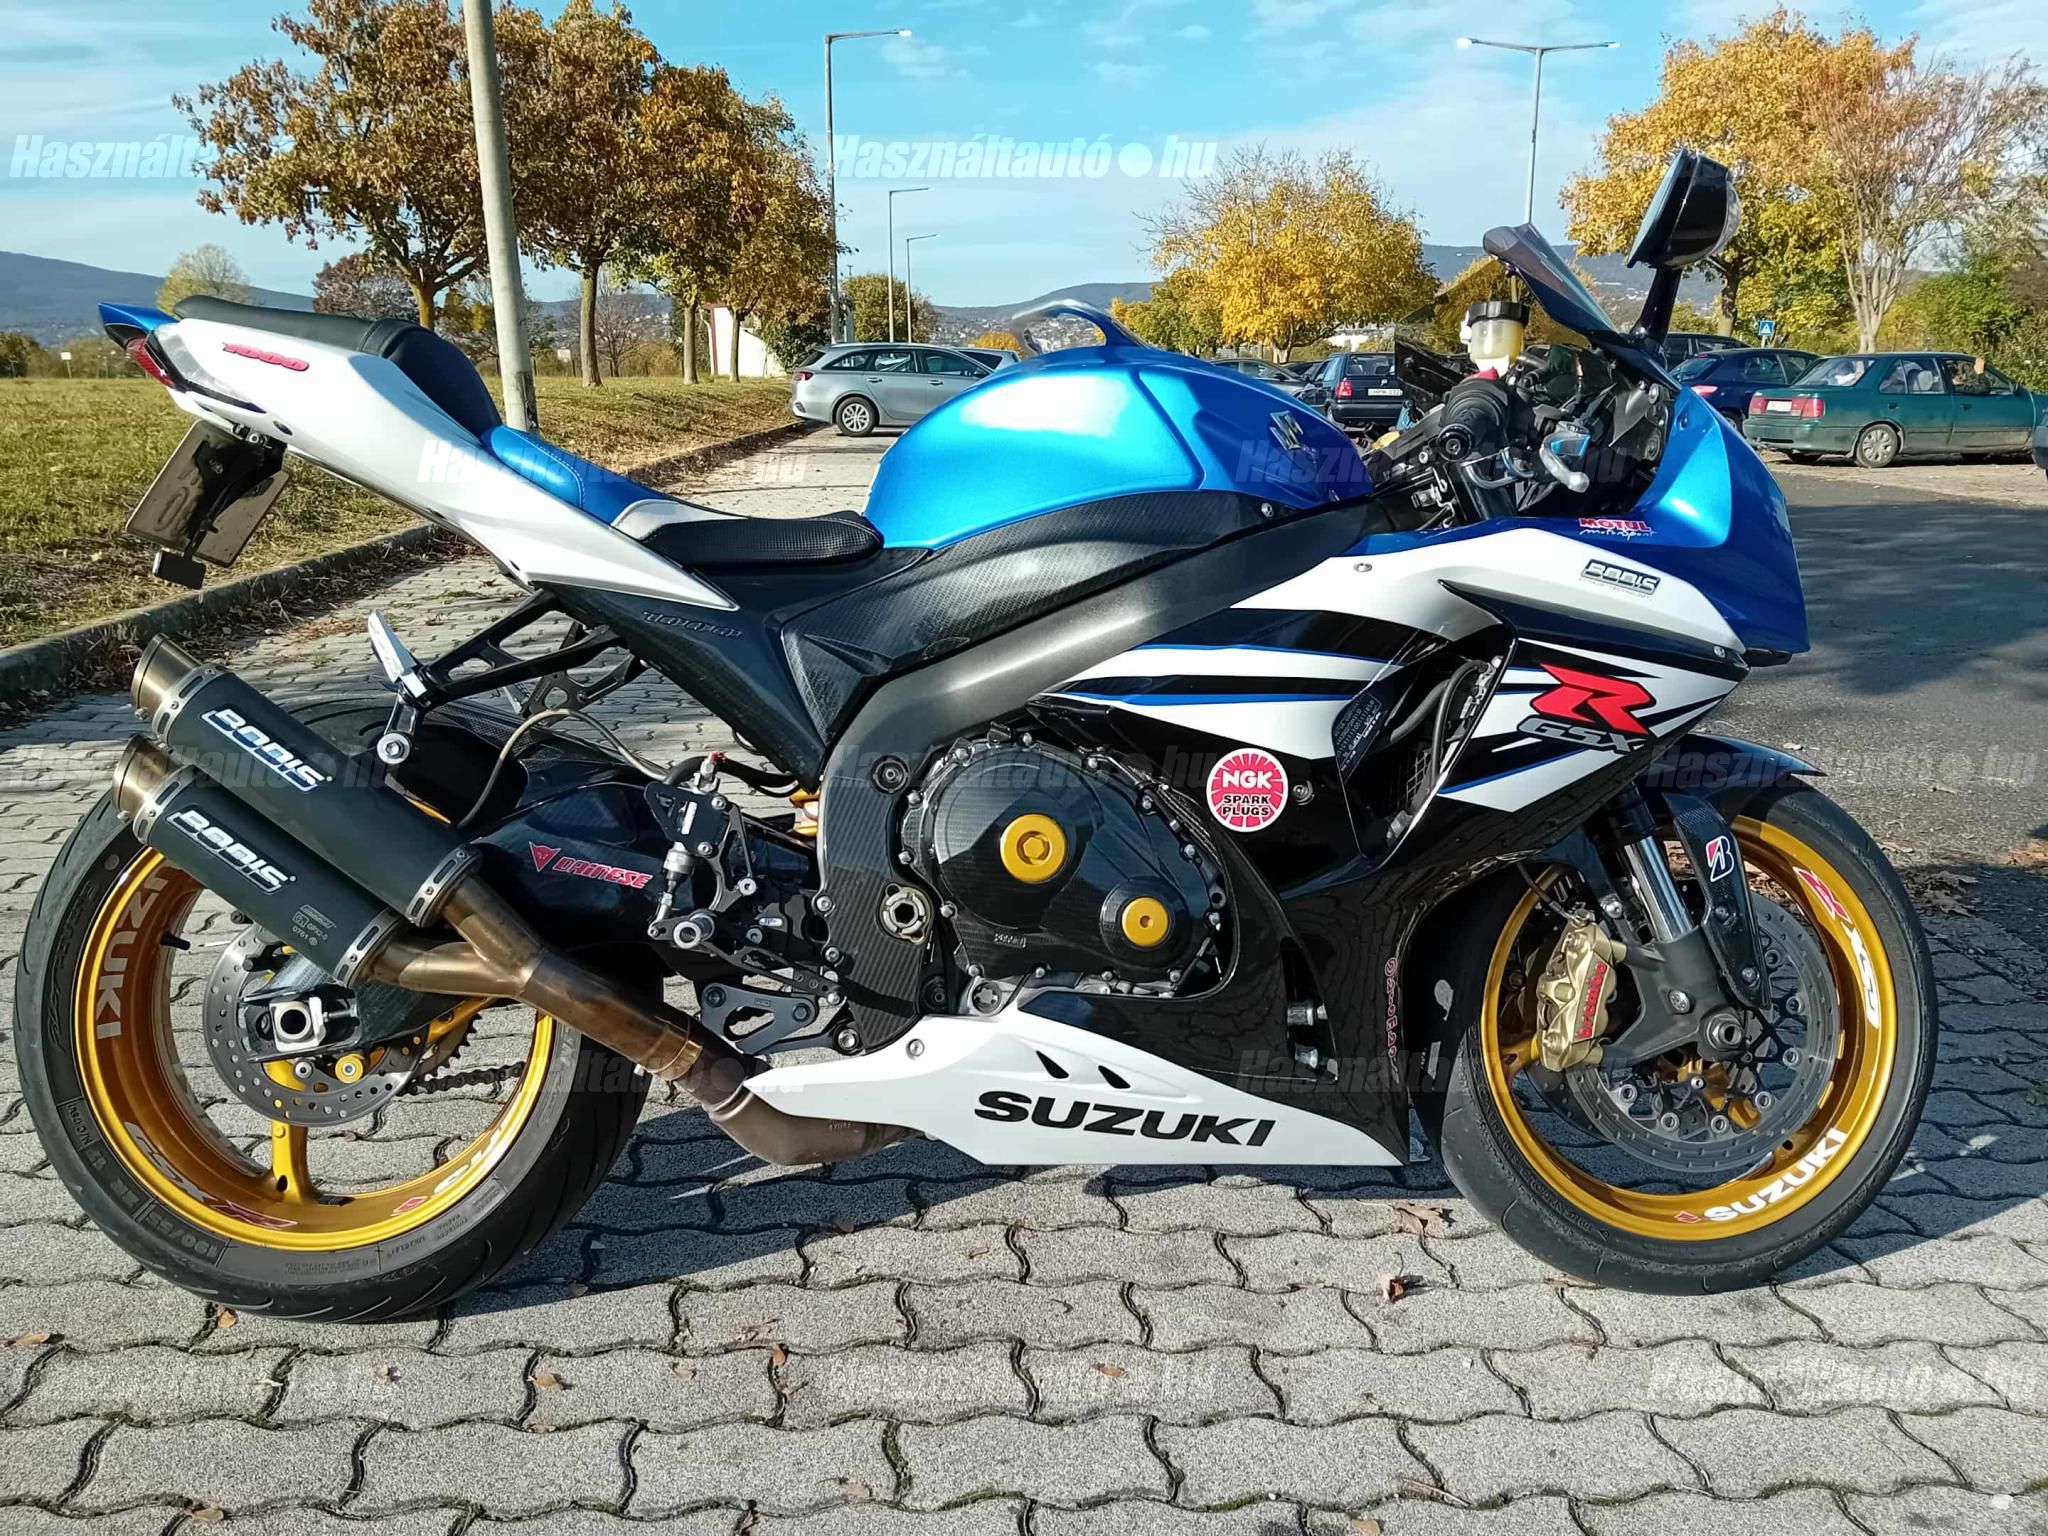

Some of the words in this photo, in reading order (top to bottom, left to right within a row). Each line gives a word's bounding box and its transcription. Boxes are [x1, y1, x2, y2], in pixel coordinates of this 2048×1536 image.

[1579, 518, 1652, 532] MOTUL
[203, 708, 328, 791] BODIS
[1222, 770, 1273, 789] NGK
[1223, 795, 1270, 804] SPARK
[1222, 806, 1270, 816] PLUGS
[166, 809, 288, 893] BODIS
[552, 856, 653, 888] DAINESE
[1575, 961, 1607, 1038] brembo
[974, 1090, 1276, 1147] SUZUKI
[1703, 1128, 1849, 1222] SUZUKI
